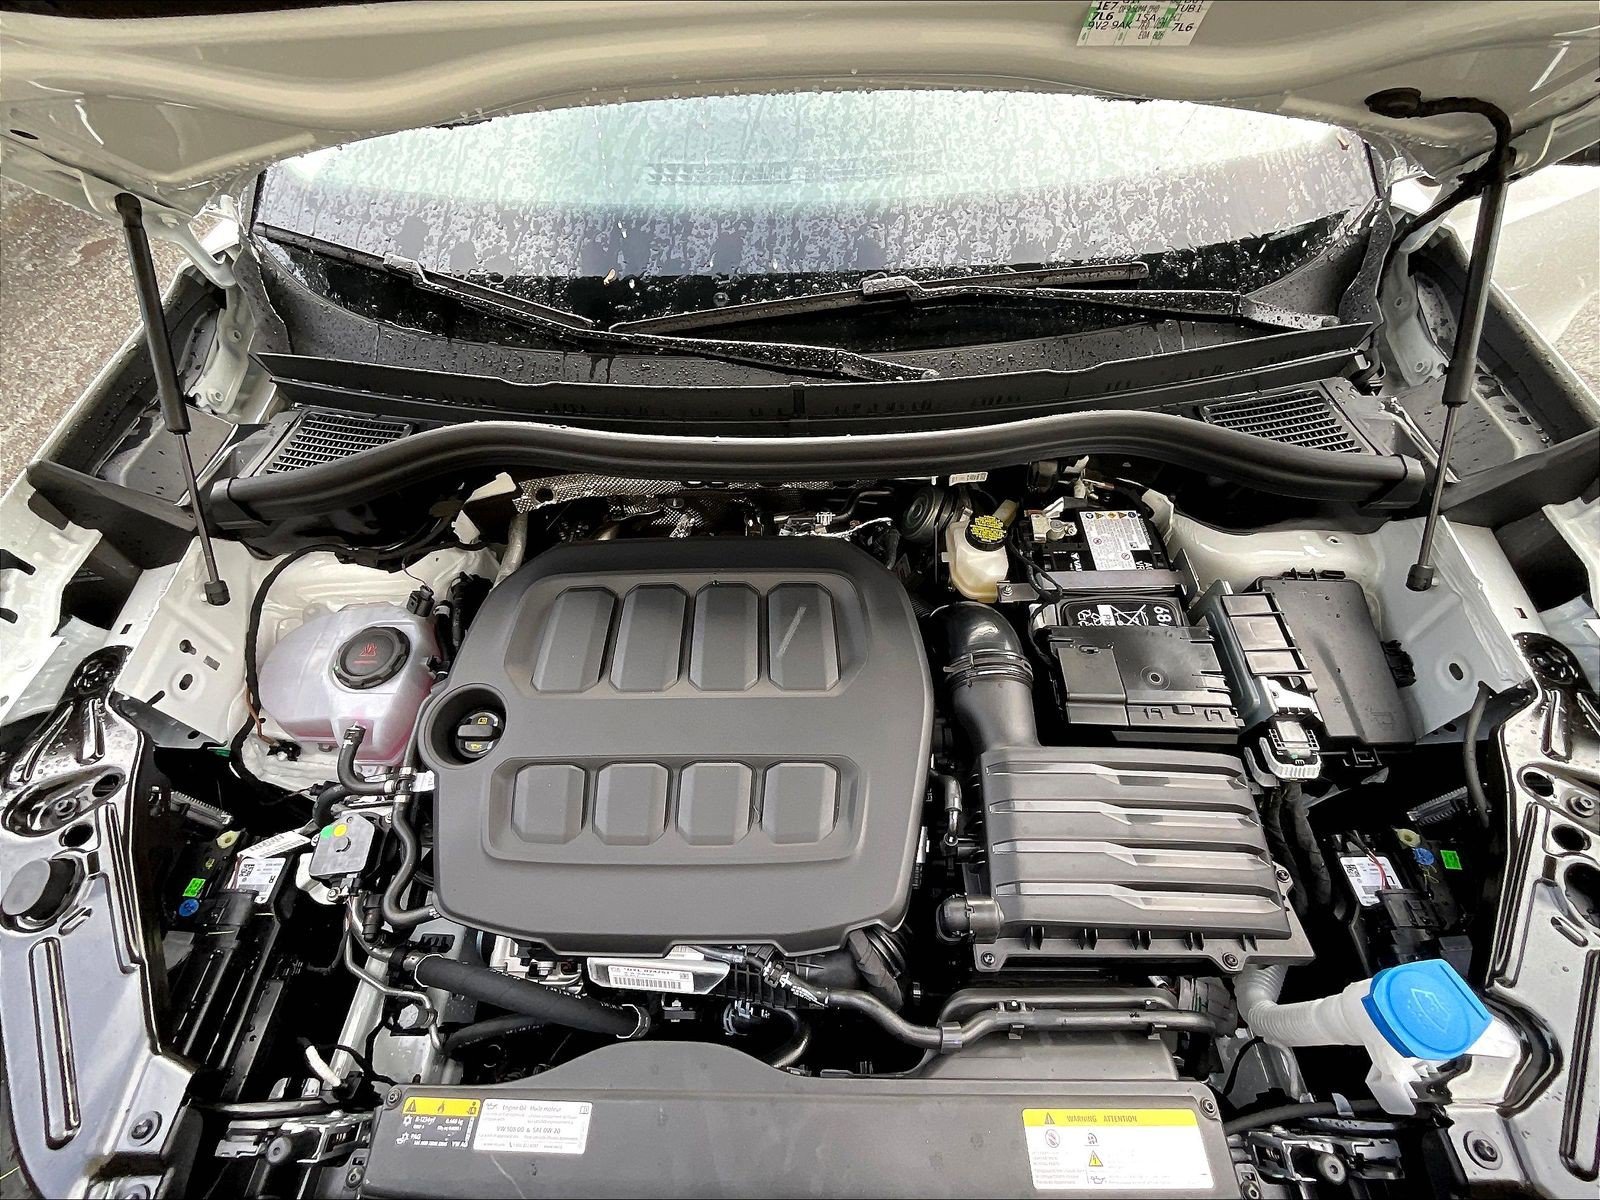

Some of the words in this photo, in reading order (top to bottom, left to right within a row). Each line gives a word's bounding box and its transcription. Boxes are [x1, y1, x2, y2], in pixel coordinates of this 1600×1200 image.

[1096, 2, 1118, 10] 1E7
[1092, 12, 1114, 20] 7L6
[1088, 21, 1108, 30] 9V2
[1111, 21, 1132, 30] 9AK
[1172, 23, 1194, 31] 7L6
